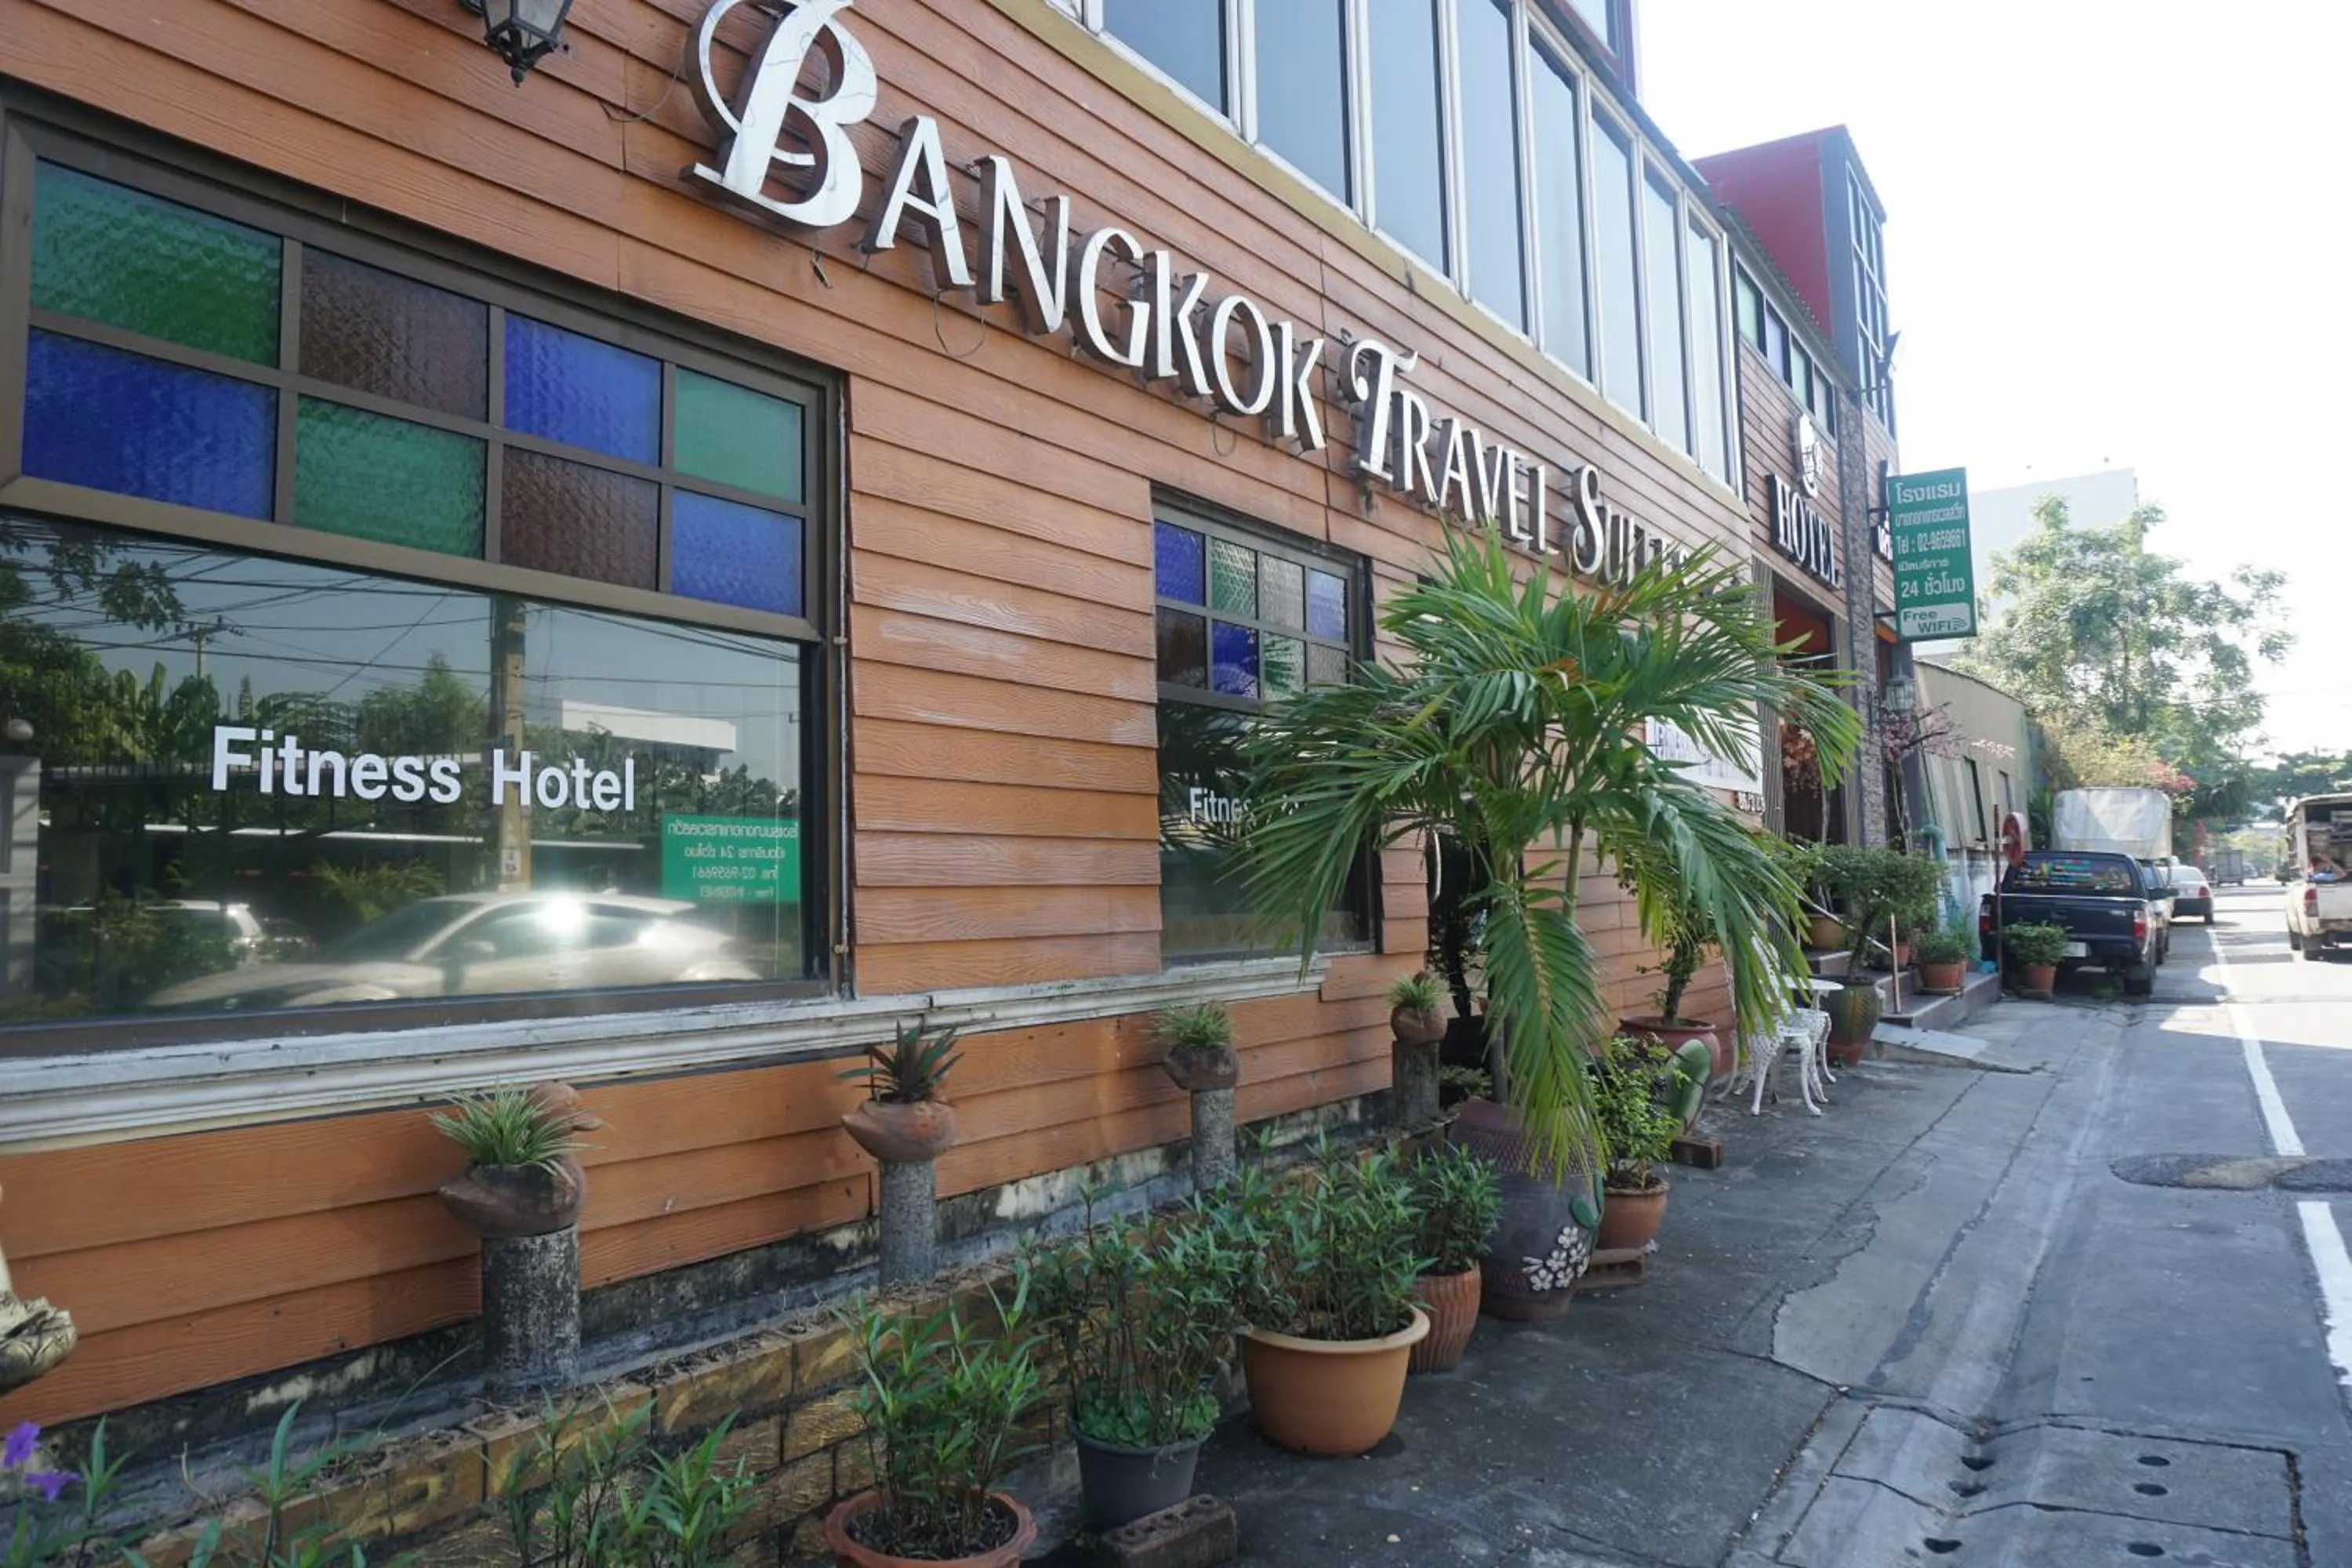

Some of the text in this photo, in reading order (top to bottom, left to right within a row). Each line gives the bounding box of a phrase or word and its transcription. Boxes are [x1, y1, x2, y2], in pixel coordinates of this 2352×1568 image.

[690, 0, 1326, 451] BANGKOK
[1348, 339, 1559, 555] TRAVEL
[1895, 481, 1962, 504] โรงแรม
[1773, 473, 1841, 589] HOTEL
[1900, 572, 1966, 598] 24 ชั่วโมง
[1903, 611, 1938, 622] Free
[212, 725, 634, 811] Fitness Hotel
